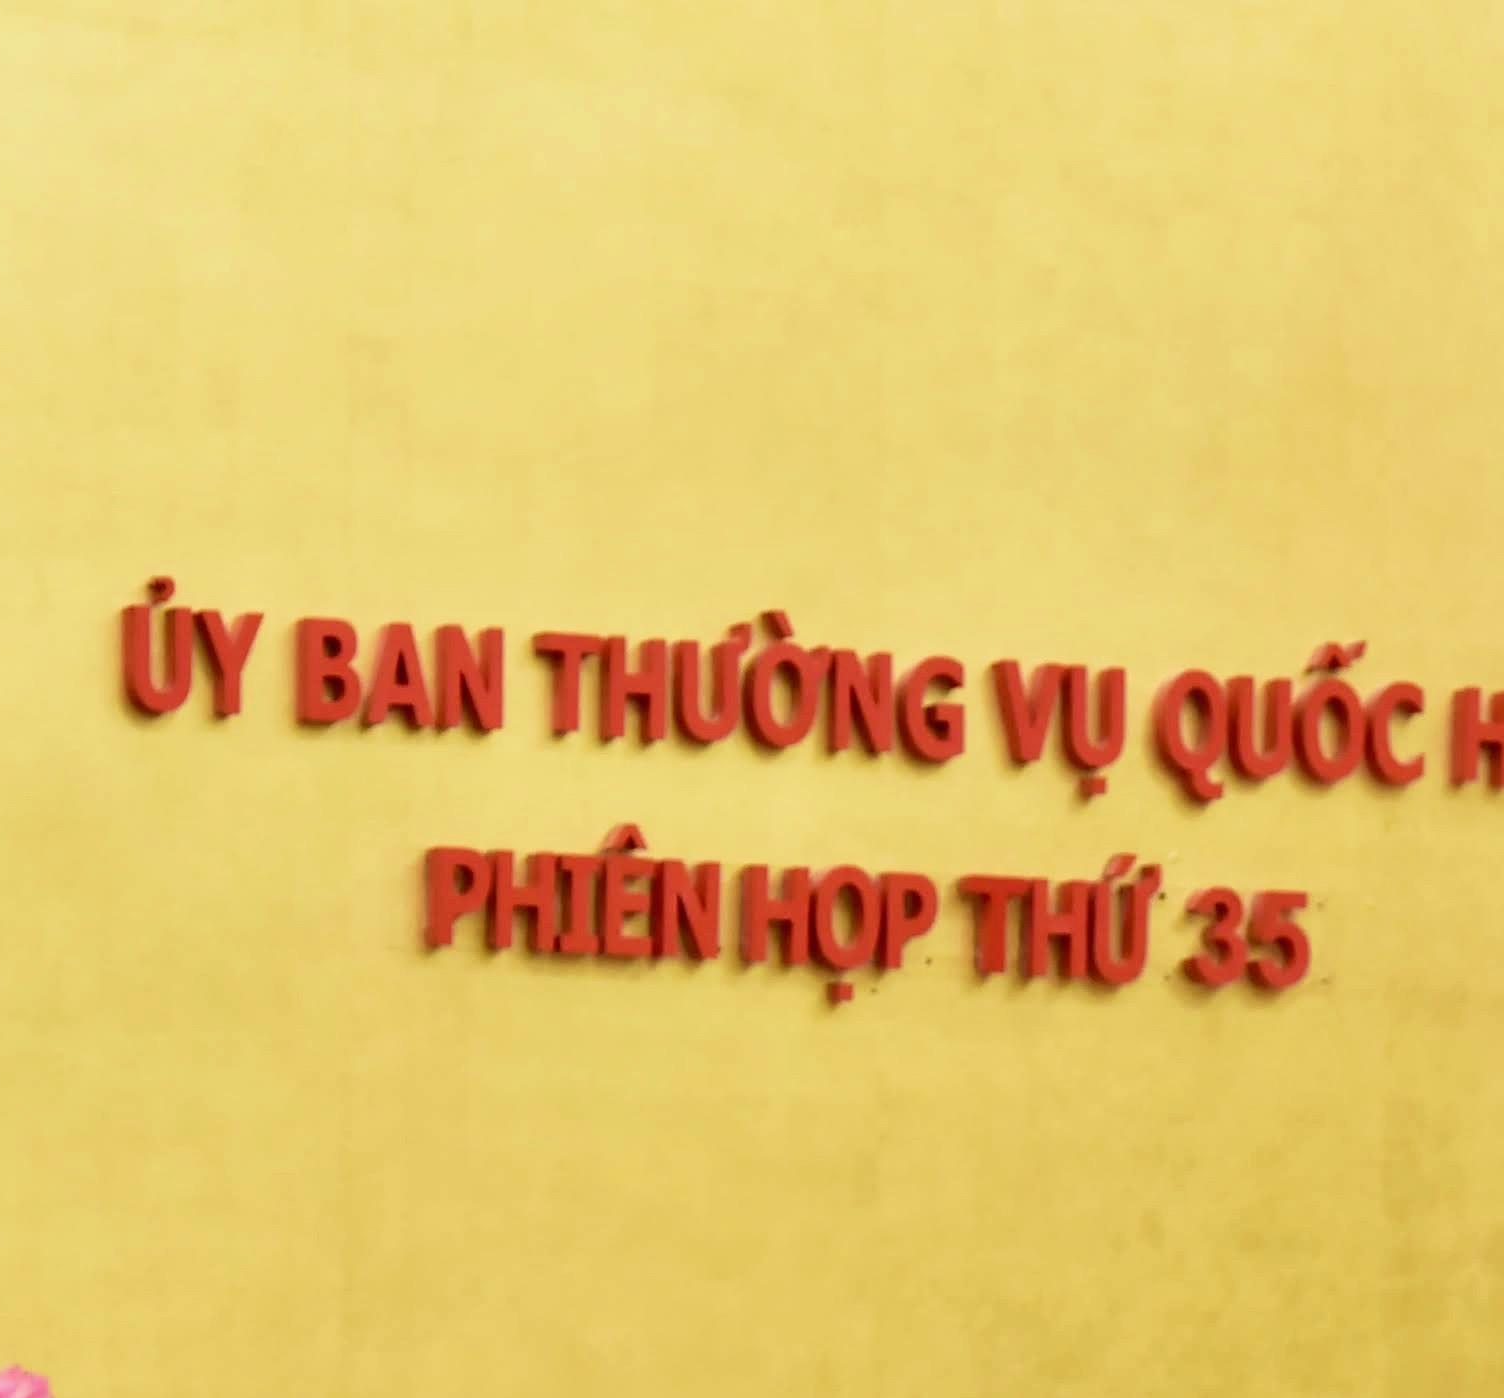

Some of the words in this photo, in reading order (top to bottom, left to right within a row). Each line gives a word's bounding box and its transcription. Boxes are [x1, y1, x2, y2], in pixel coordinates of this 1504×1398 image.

[121, 575, 264, 718] ỦY
[294, 616, 504, 733] BAN
[532, 609, 964, 764] THƯỜNG
[988, 658, 1127, 798] VỤ
[1152, 639, 1425, 801] QUỐC
[423, 822, 722, 962] PHIÊN
[738, 861, 939, 1005] HỌP
[955, 852, 1163, 988] THỨ
[1181, 886, 1312, 991] 35
